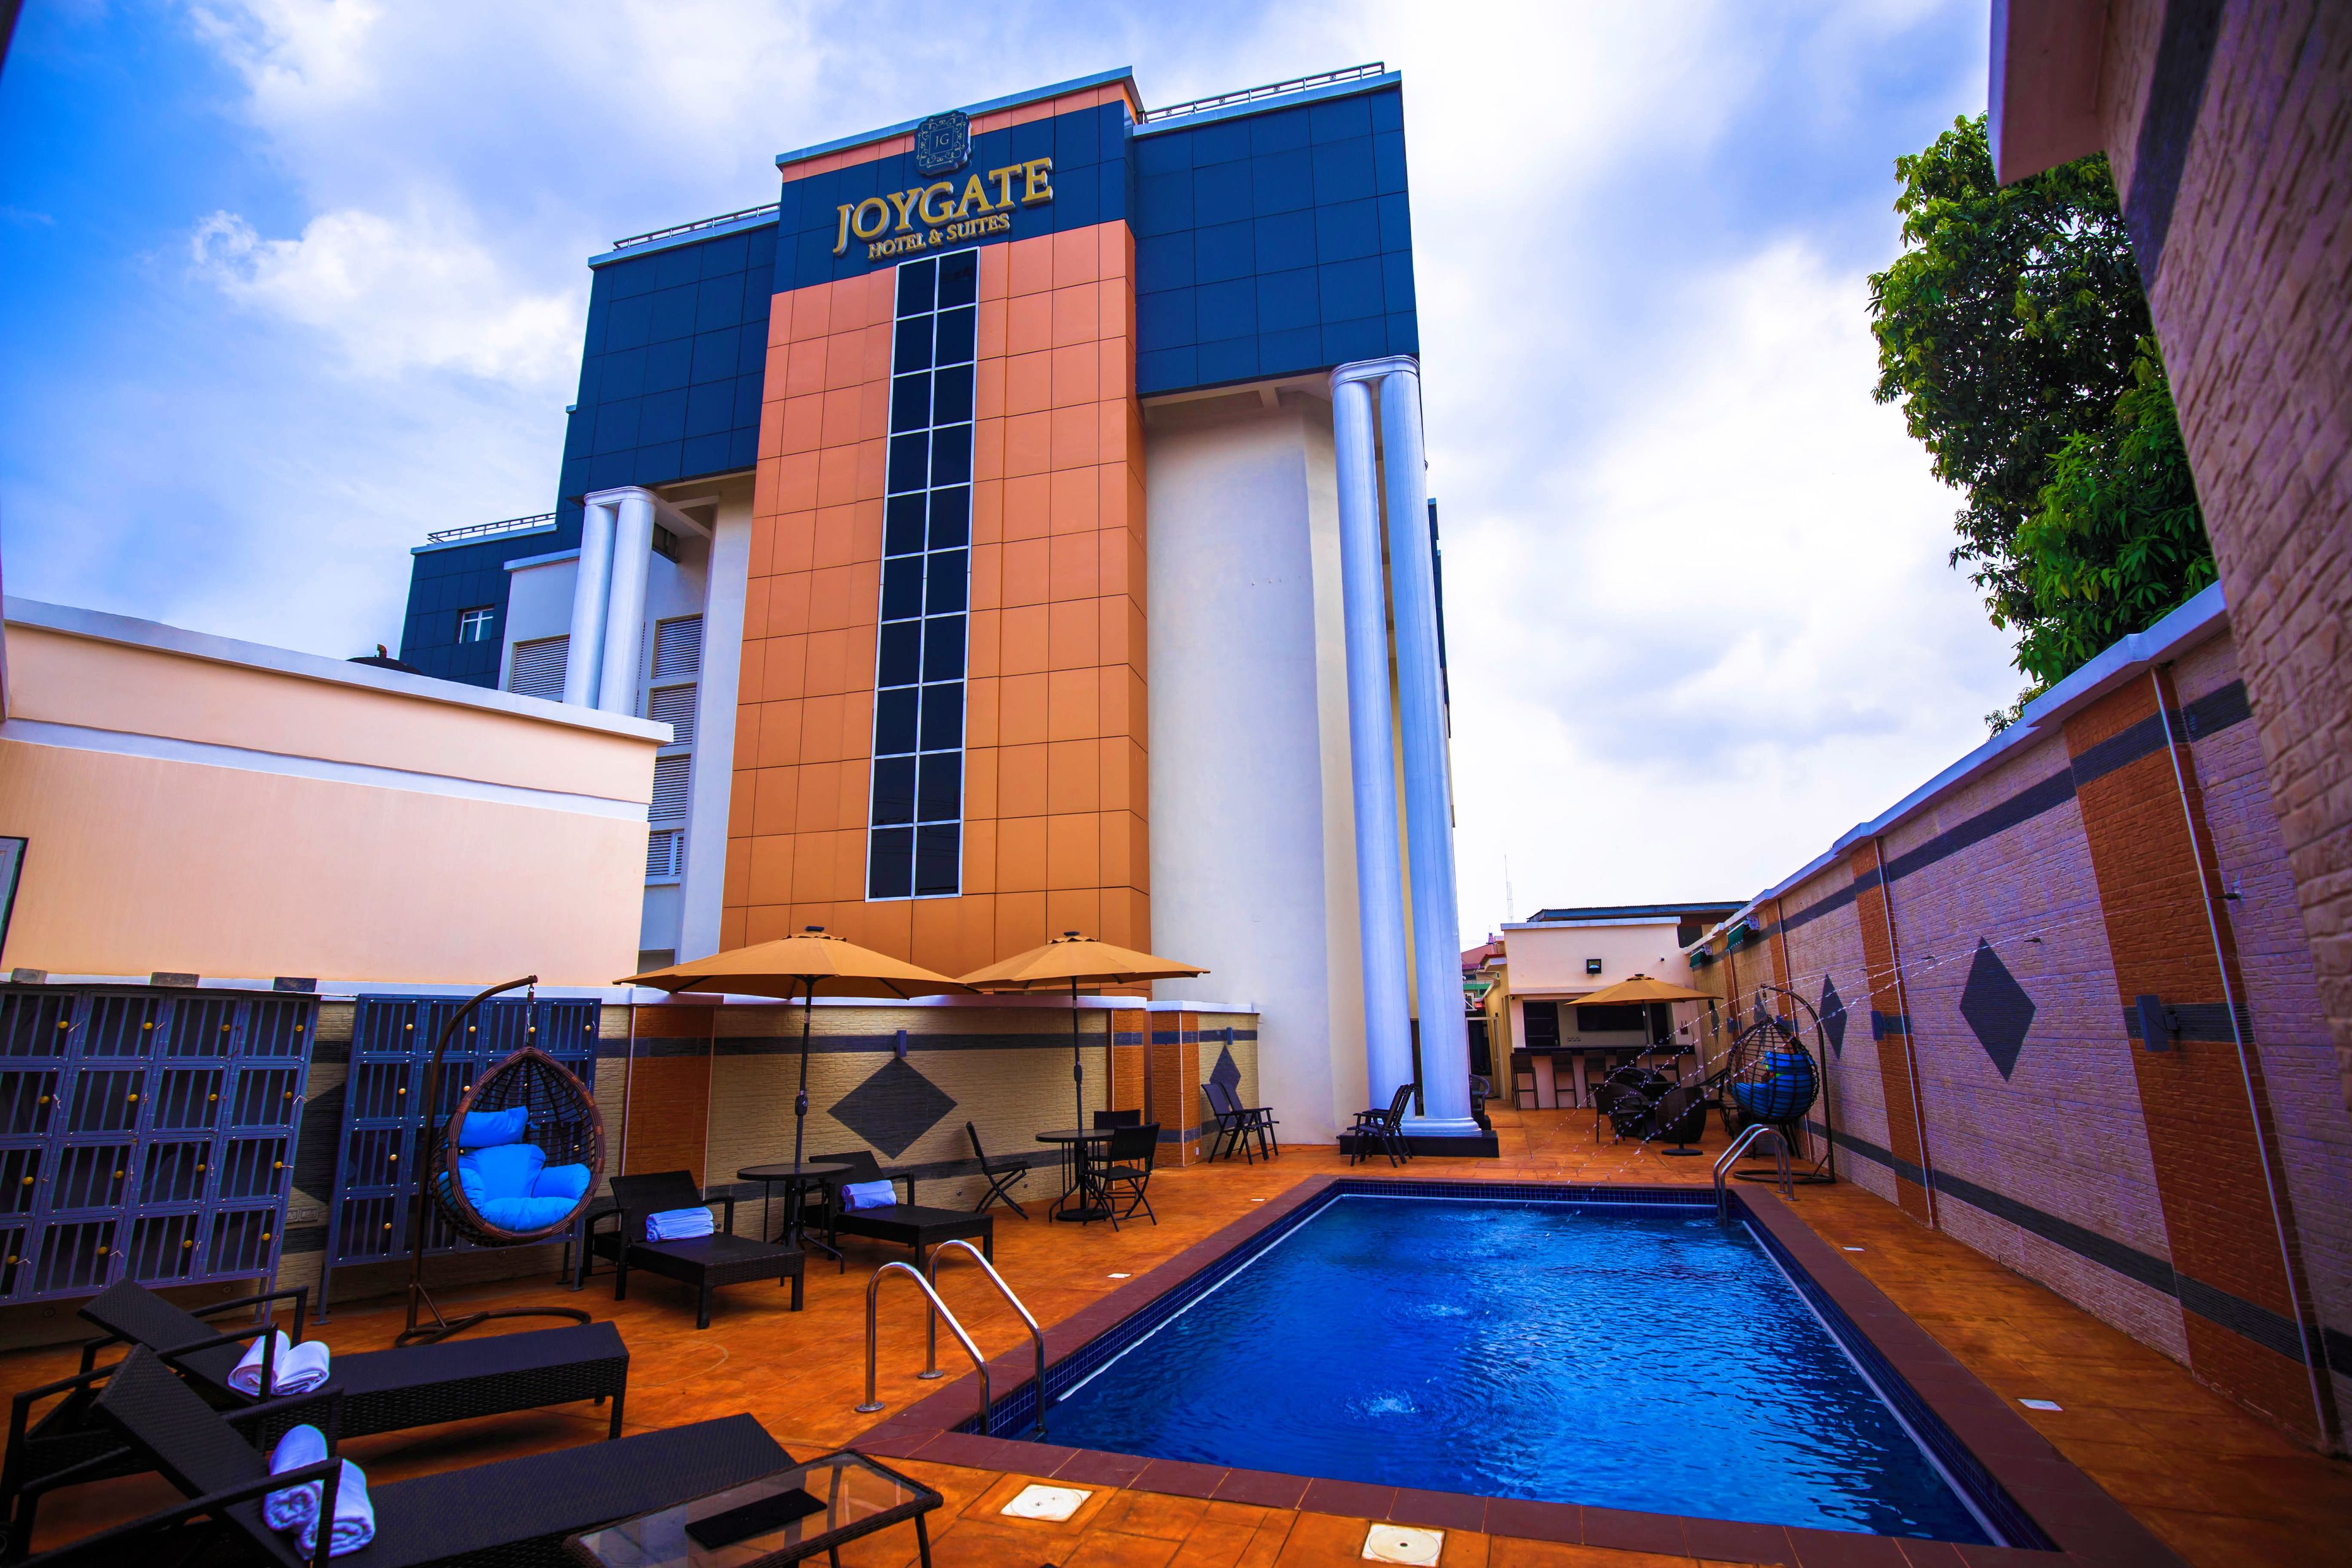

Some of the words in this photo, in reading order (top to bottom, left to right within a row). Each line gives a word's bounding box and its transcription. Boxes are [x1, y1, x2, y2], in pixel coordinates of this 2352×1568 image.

[833, 157, 1053, 256] JOYGATE
[868, 233, 925, 260] HOTEL
[928, 228, 943, 246] &
[946, 213, 1010, 242] SUITES
